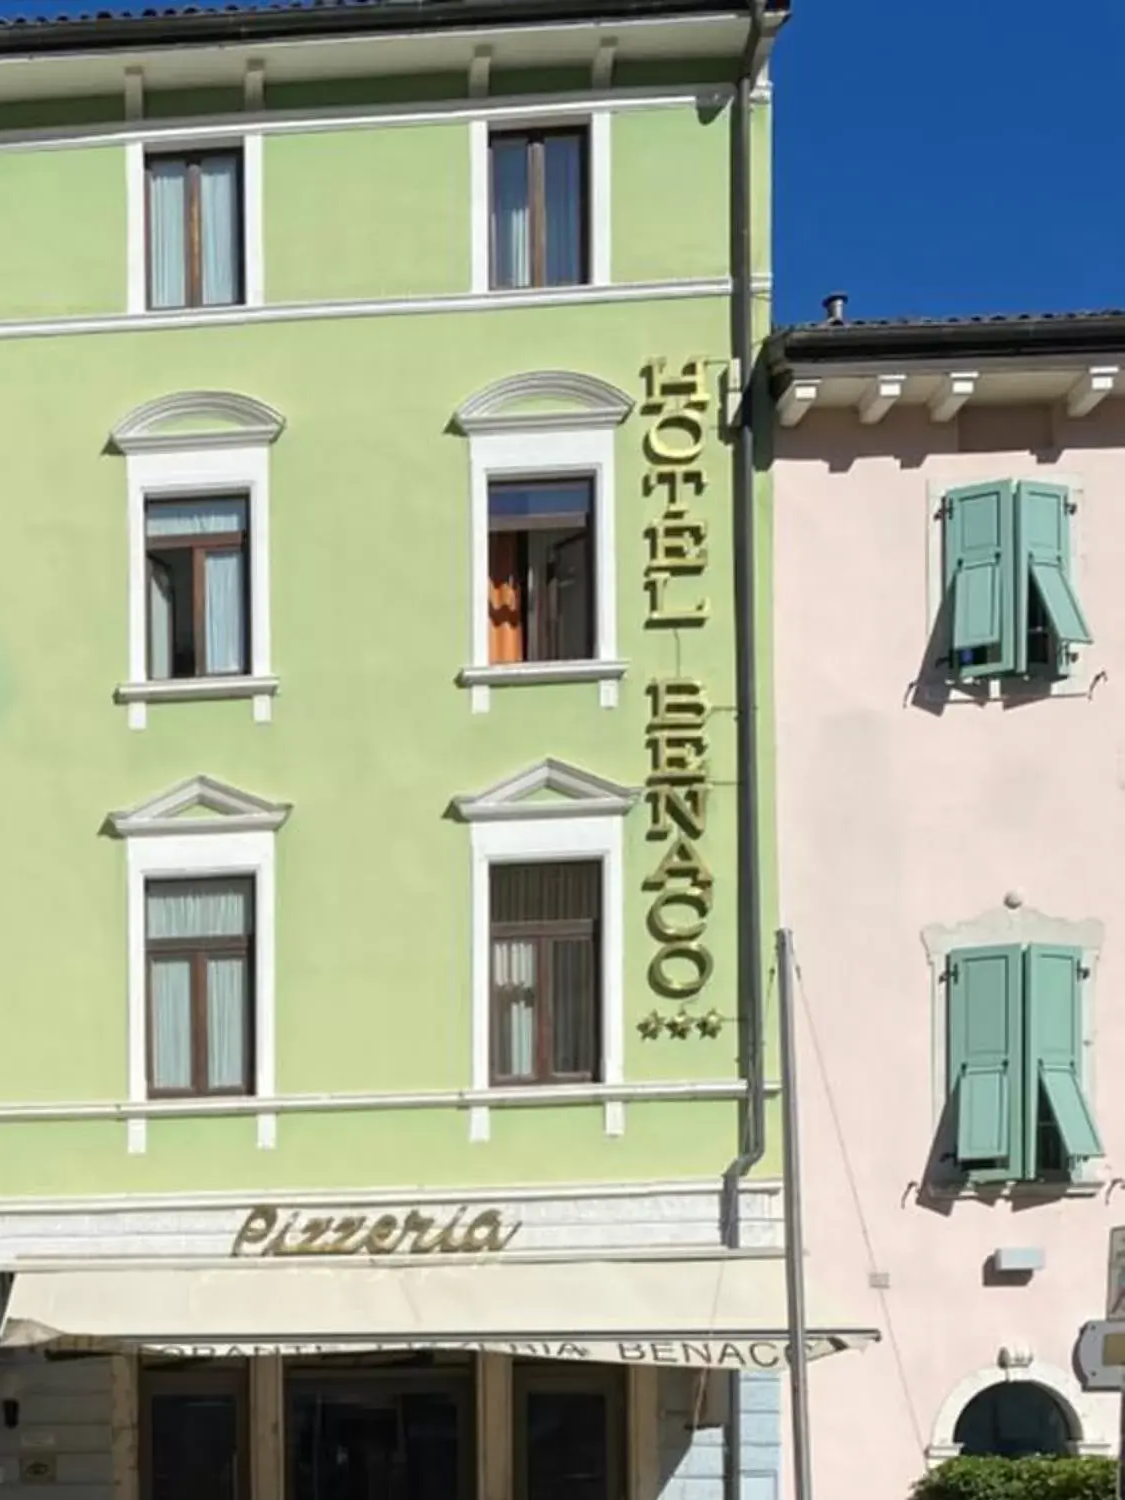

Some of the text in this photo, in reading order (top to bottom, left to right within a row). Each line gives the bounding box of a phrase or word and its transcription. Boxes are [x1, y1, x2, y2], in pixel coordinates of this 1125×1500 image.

[641, 356, 713, 998] HOTEL BENACO
[229, 1204, 523, 1257] Pizzeria
